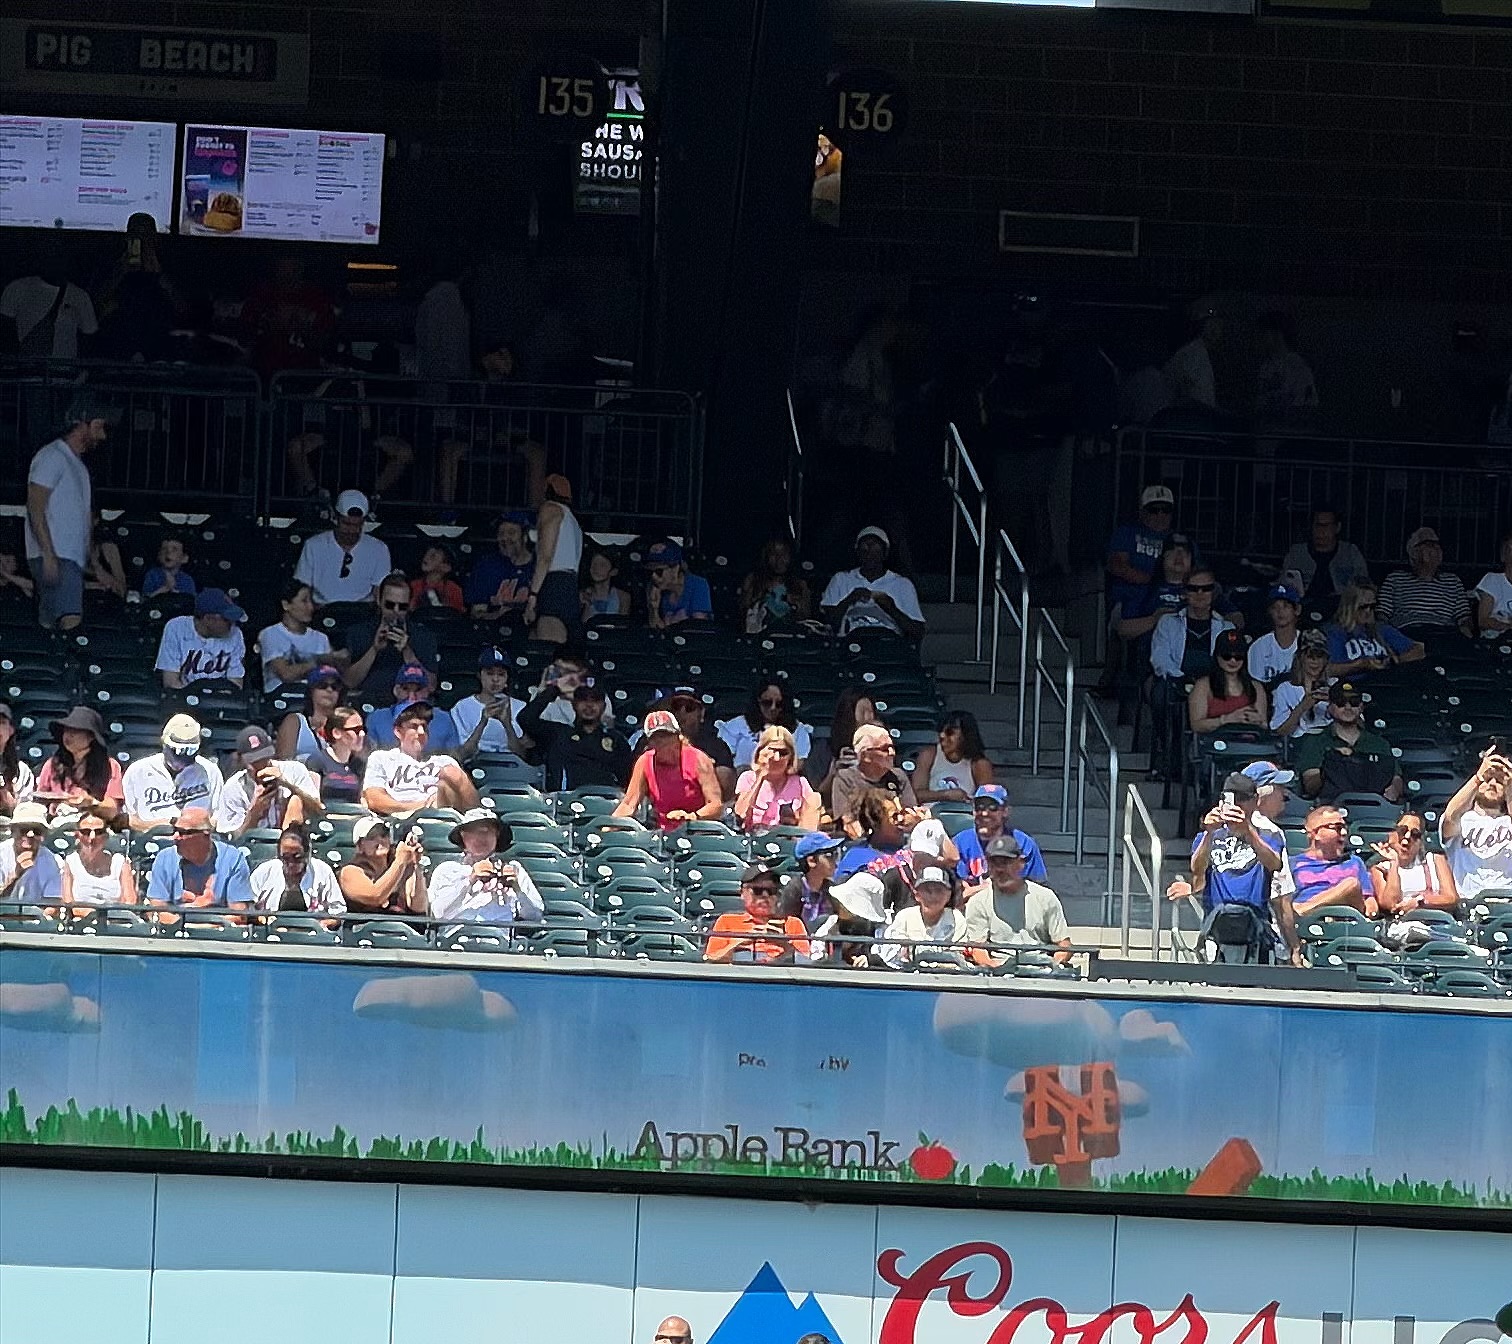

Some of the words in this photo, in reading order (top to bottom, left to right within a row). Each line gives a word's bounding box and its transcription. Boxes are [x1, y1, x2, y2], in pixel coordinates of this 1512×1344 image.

[35, 34, 92, 65] PIG
[139, 38, 254, 73] BEACH
[538, 77, 593, 117] 135
[838, 91, 893, 133] 136
[580, 142, 643, 161] SAUS
[580, 163, 642, 181] SHOU
[631, 1120, 769, 1169] Apple
[775, 1126, 901, 1170] Bank
